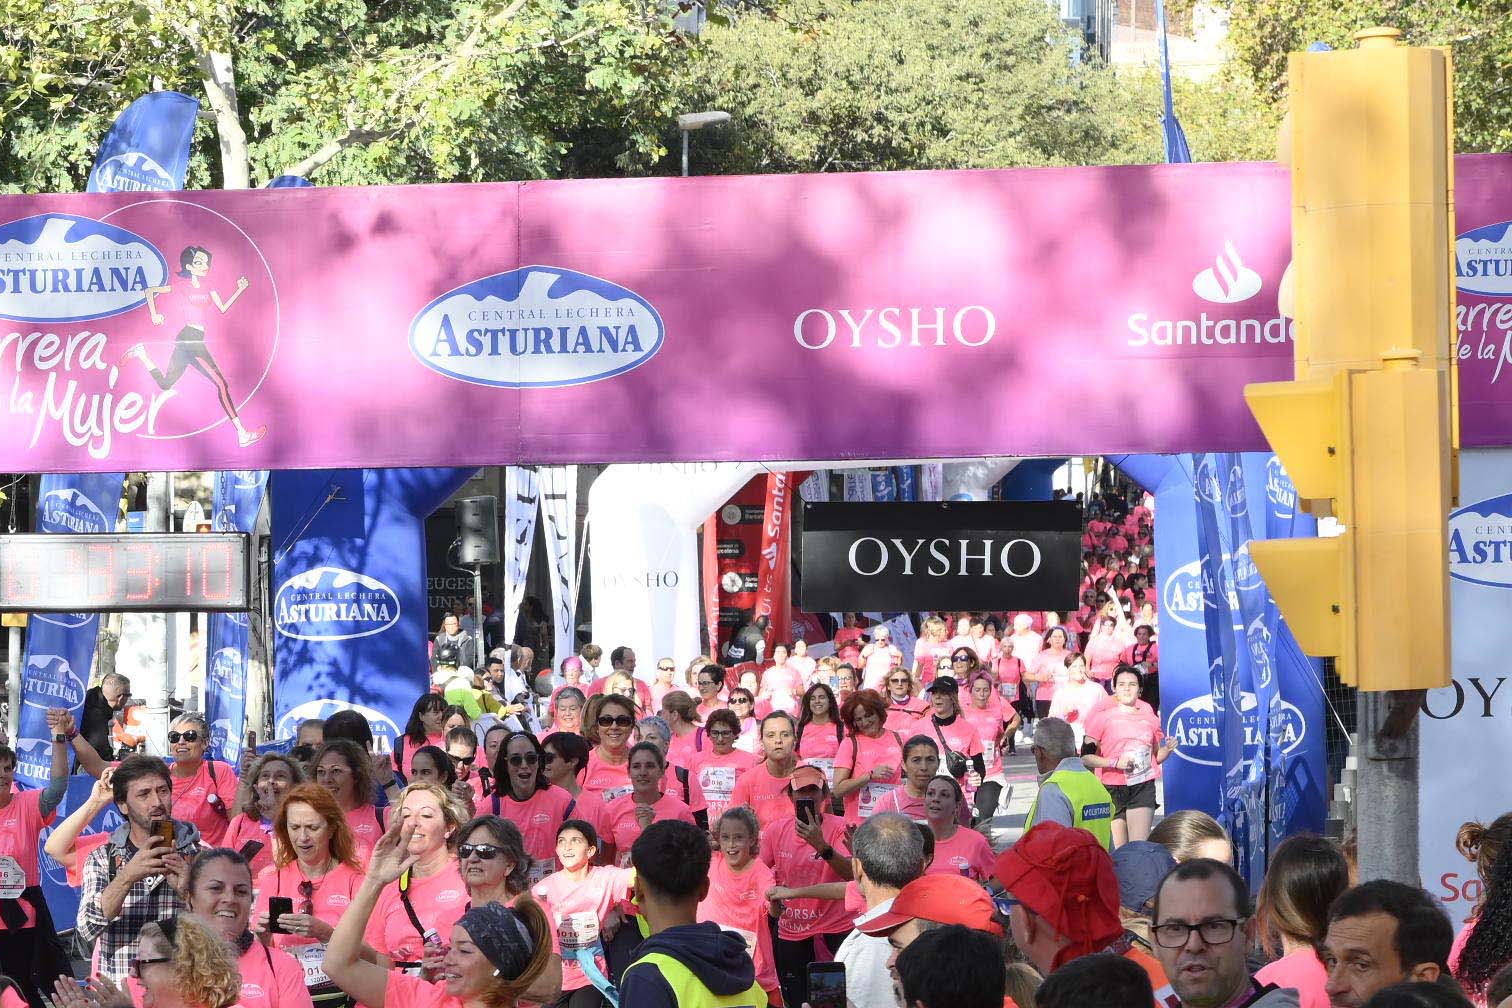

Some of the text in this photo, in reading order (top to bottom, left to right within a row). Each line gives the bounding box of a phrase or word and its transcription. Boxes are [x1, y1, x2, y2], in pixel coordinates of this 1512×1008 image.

[70, 248, 144, 260] LECHERA
[468, 307, 636, 321] CENTRAL LECHERA
[793, 306, 997, 350] OYSHO
[430, 313, 645, 357] ASTURIANA
[8, 376, 36, 416] la
[29, 366, 179, 460] Mujer
[849, 537, 1041, 578] OYSHO
[277, 596, 391, 625] ASTURIANA
[290, 591, 387, 601] CENTRAL LECHERA
